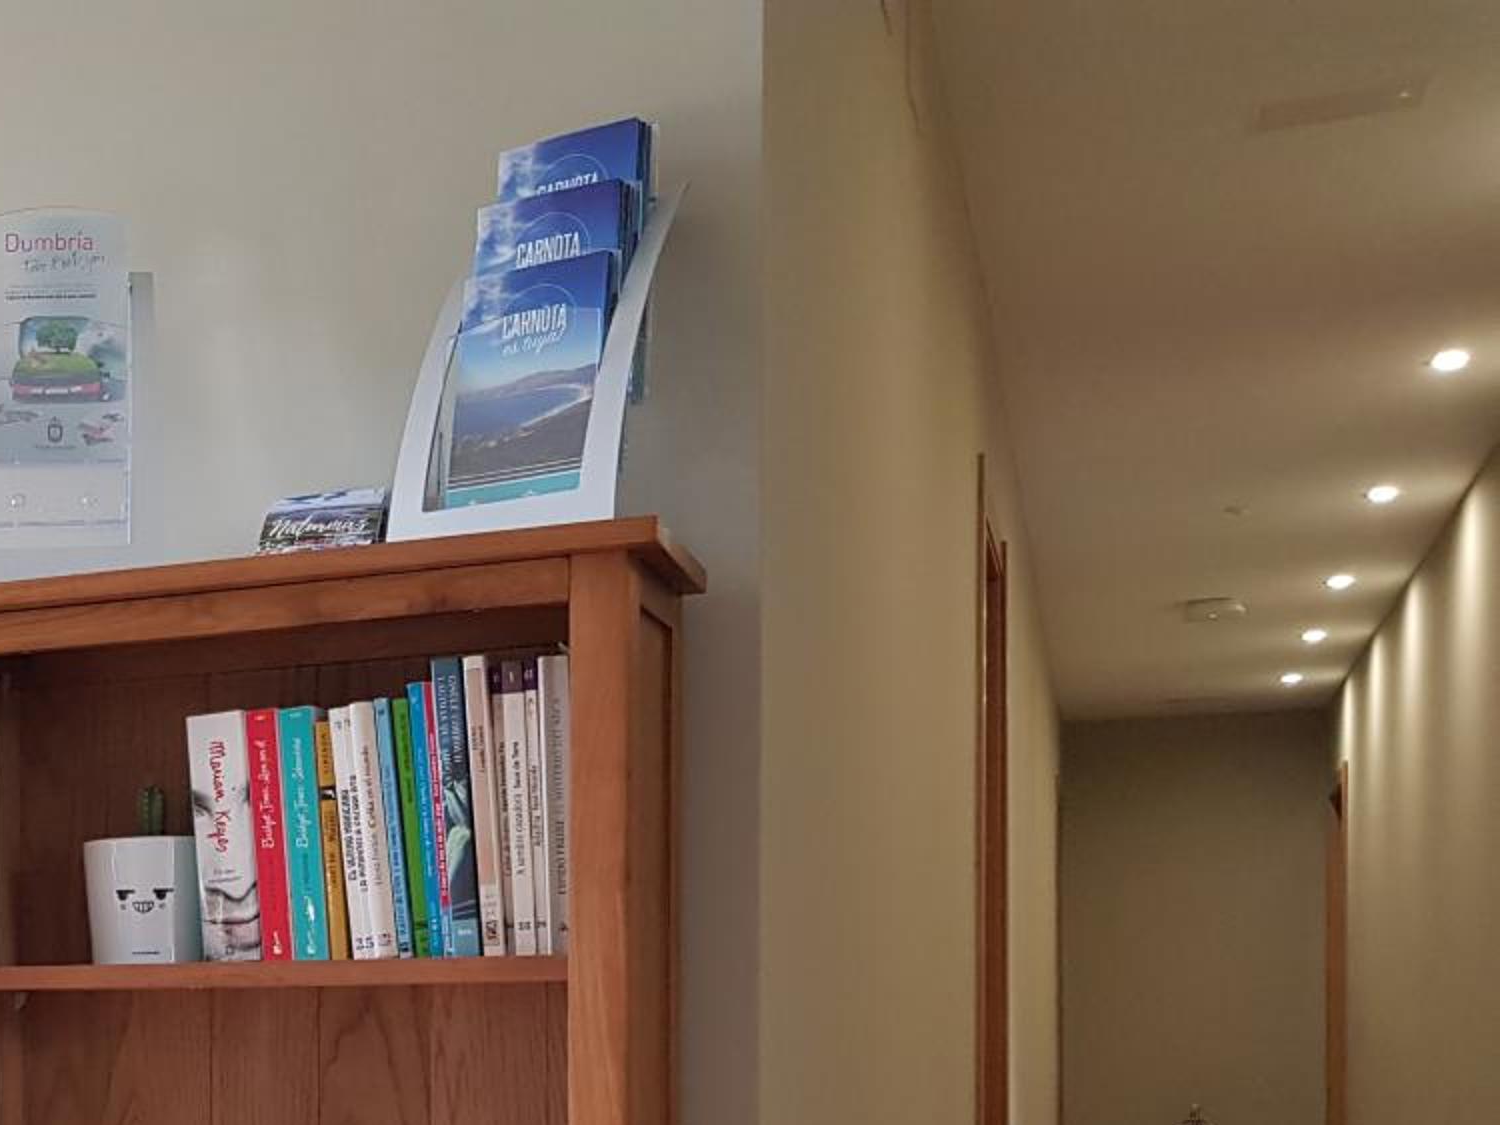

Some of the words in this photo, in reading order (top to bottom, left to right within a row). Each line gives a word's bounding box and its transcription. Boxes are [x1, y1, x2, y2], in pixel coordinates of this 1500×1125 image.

[515, 231, 581, 269] CARNOTA
[502, 304, 567, 339] CARNOTA
[209, 740, 227, 801] Marian
[207, 809, 231, 853] Keyes
